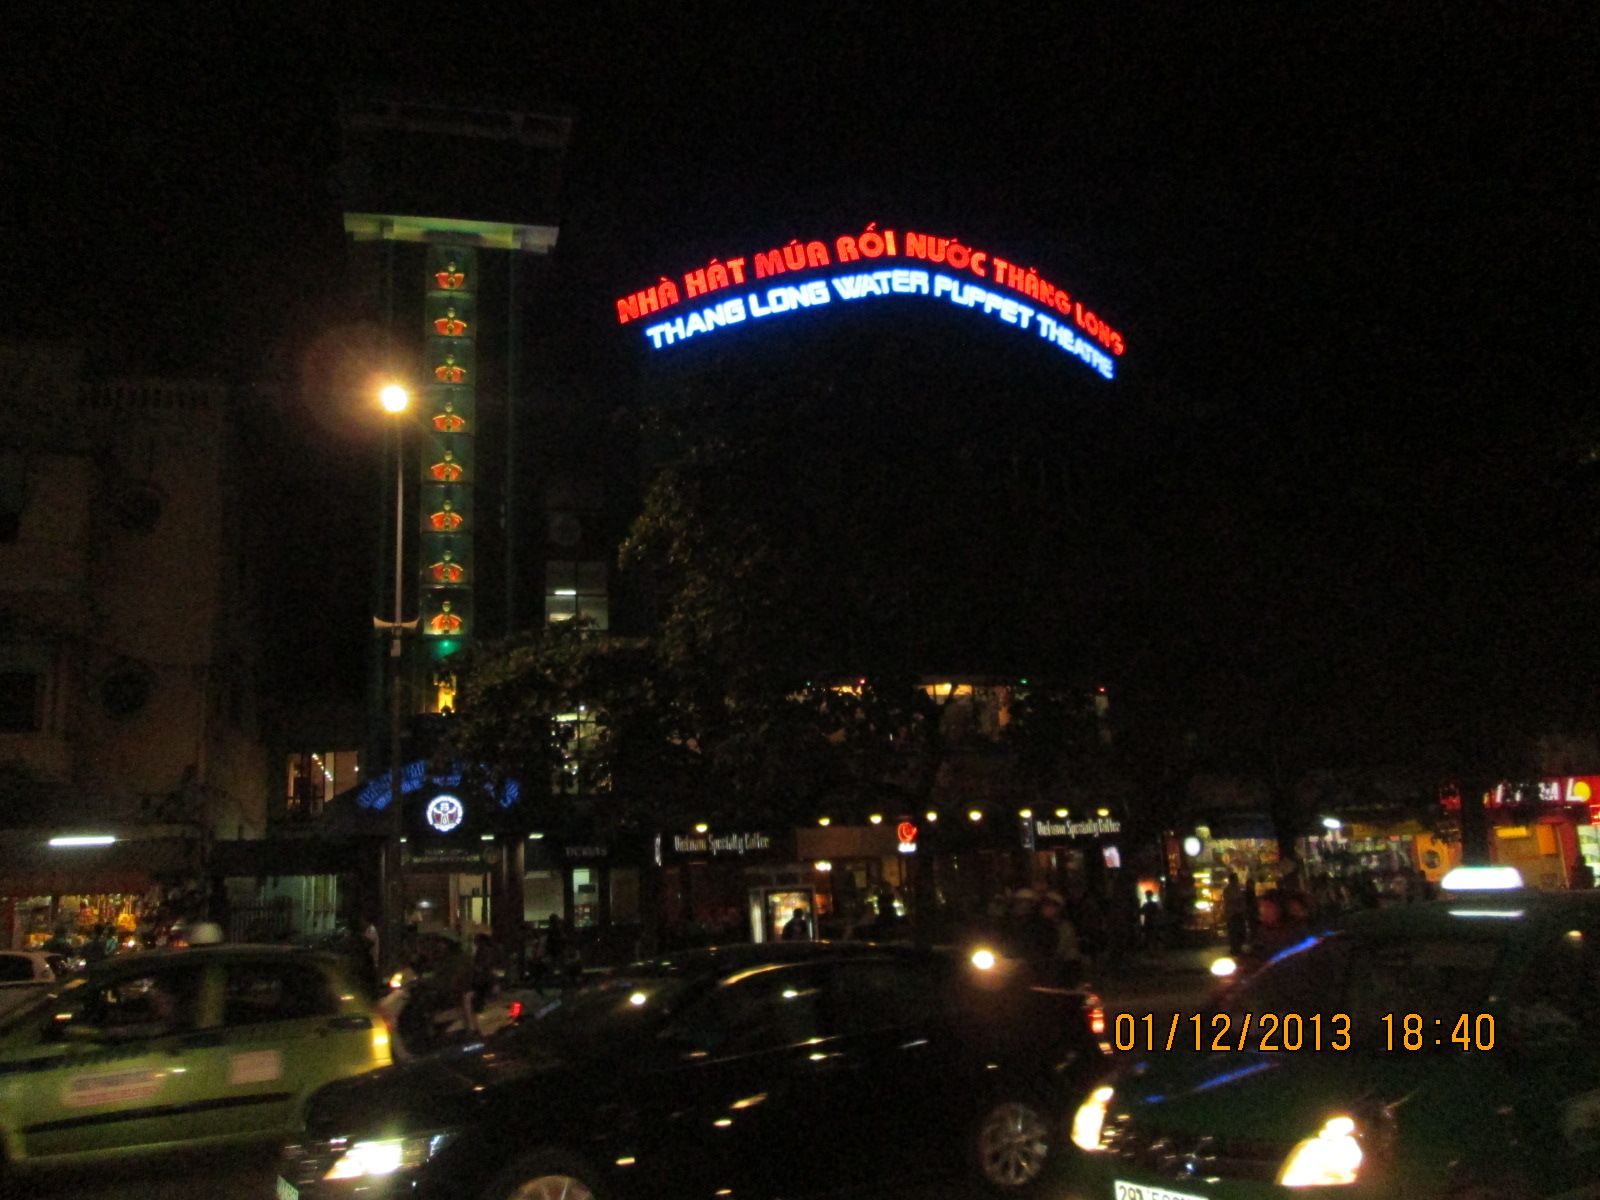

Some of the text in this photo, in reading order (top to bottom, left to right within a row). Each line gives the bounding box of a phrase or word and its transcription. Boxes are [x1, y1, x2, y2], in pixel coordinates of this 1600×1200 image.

[616, 222, 1125, 356] NHÀ HÁT MÚA RỐI NƯỚC THĂNG LONG
[646, 269, 1115, 380] THANG LONG WATER PUPPET THEATRE
[708, 832, 744, 856] Specialty
[743, 832, 771, 850] Coffee
